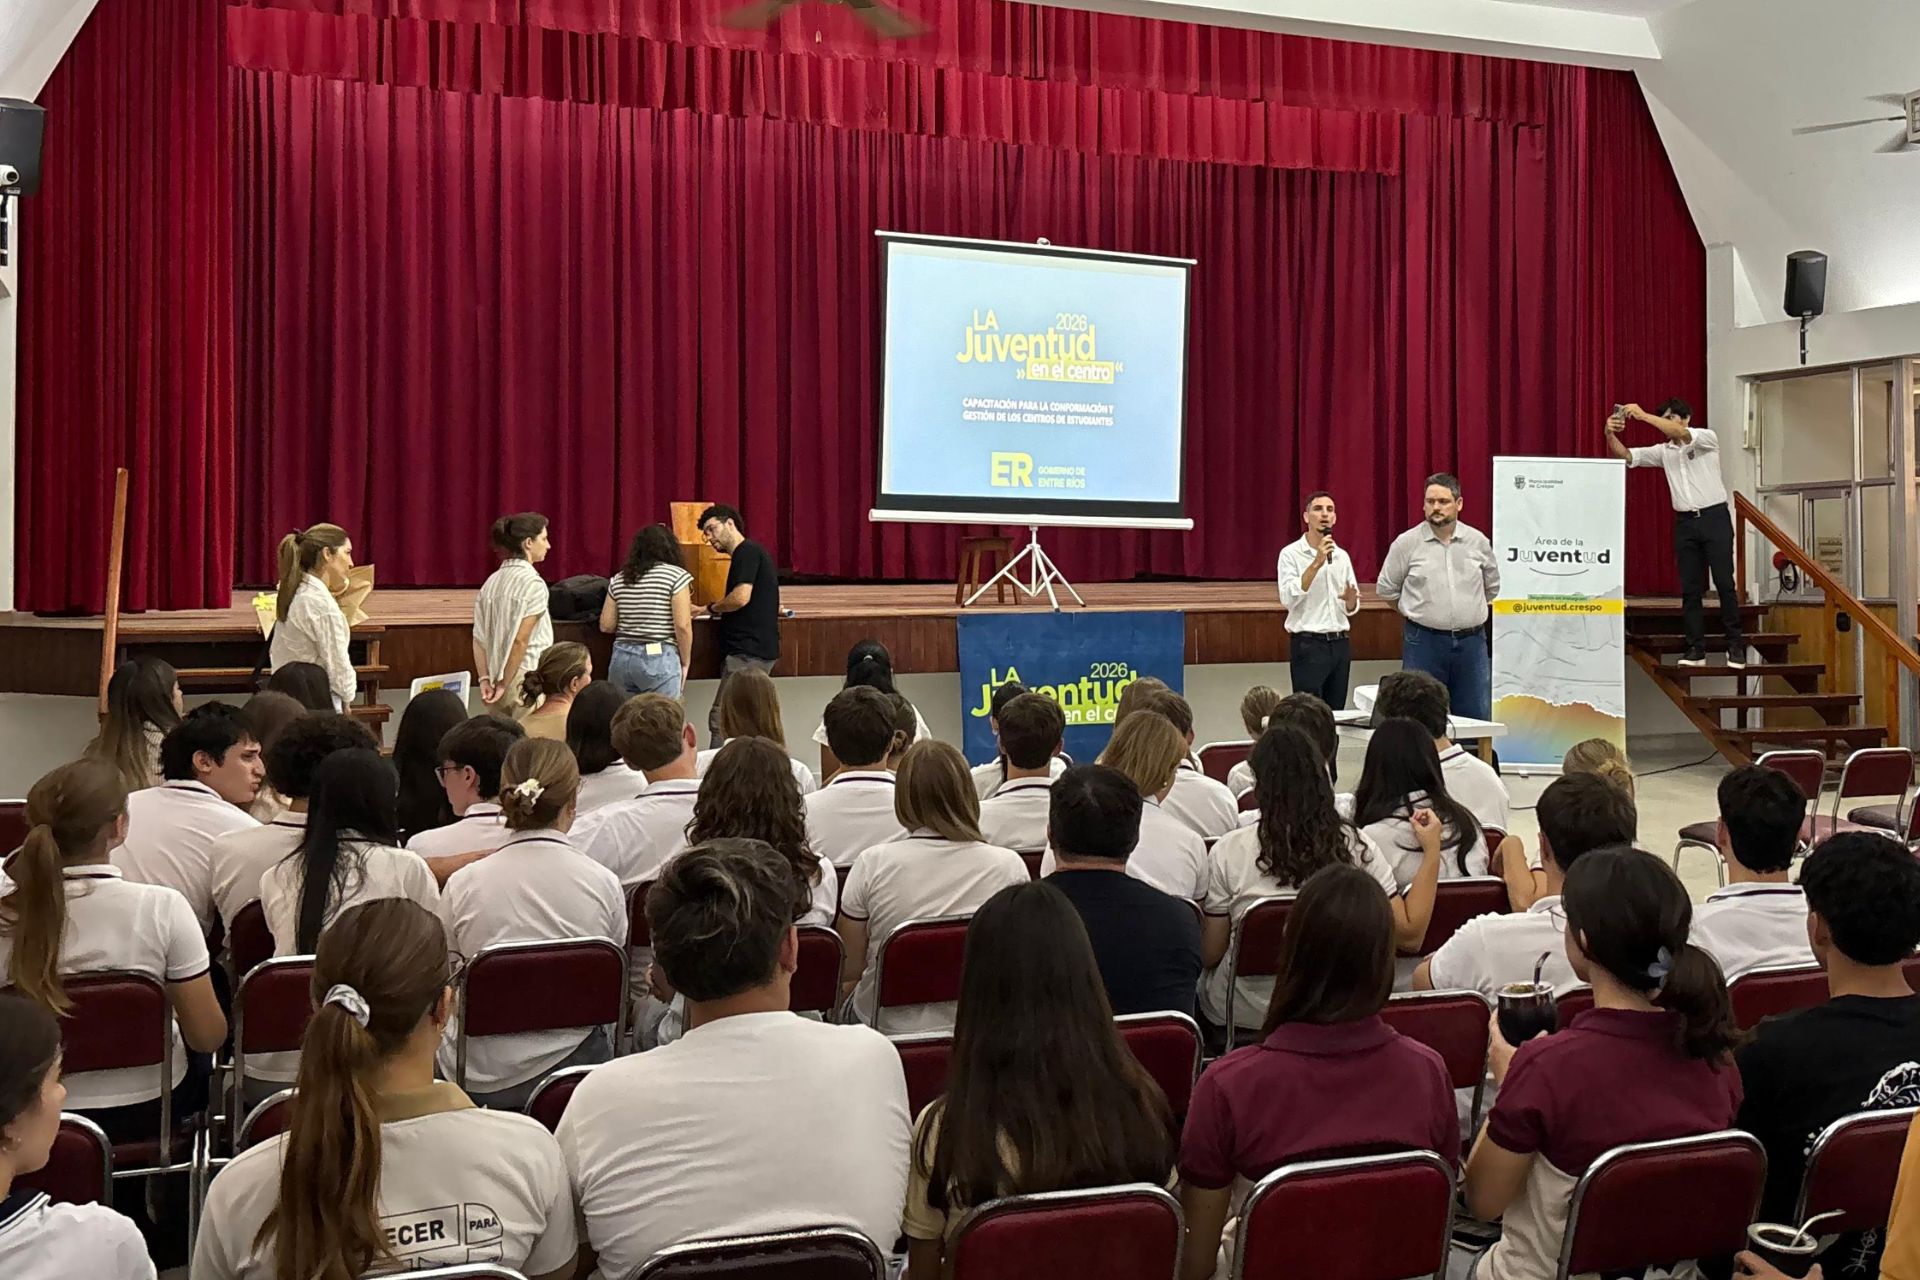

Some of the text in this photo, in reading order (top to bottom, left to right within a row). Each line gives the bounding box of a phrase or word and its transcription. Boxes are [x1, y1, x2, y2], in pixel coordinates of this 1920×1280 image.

[973, 308, 999, 331] LA
[1056, 312, 1088, 332] 2026
[956, 324, 1096, 363] Juventud
[1031, 361, 1111, 381] en el centro
[962, 397, 1114, 414] CAPACITACIÓN PARA LA CONFORMACIÓN Y
[962, 410, 1114, 426] GESTIÓN DE LOS CENTROS DE ESTUDIANTES
[990, 451, 1034, 488] ER
[1535, 536, 1584, 546] Área de la
[1507, 547, 1611, 564] Juventud
[1512, 602, 1602, 613] @juventud.crespo
[991, 666, 1021, 687] LA
[1090, 662, 1128, 679] 2026
[1065, 709, 1082, 722] en
[1085, 707, 1100, 721] el
[469, 1216, 498, 1231] PARA
